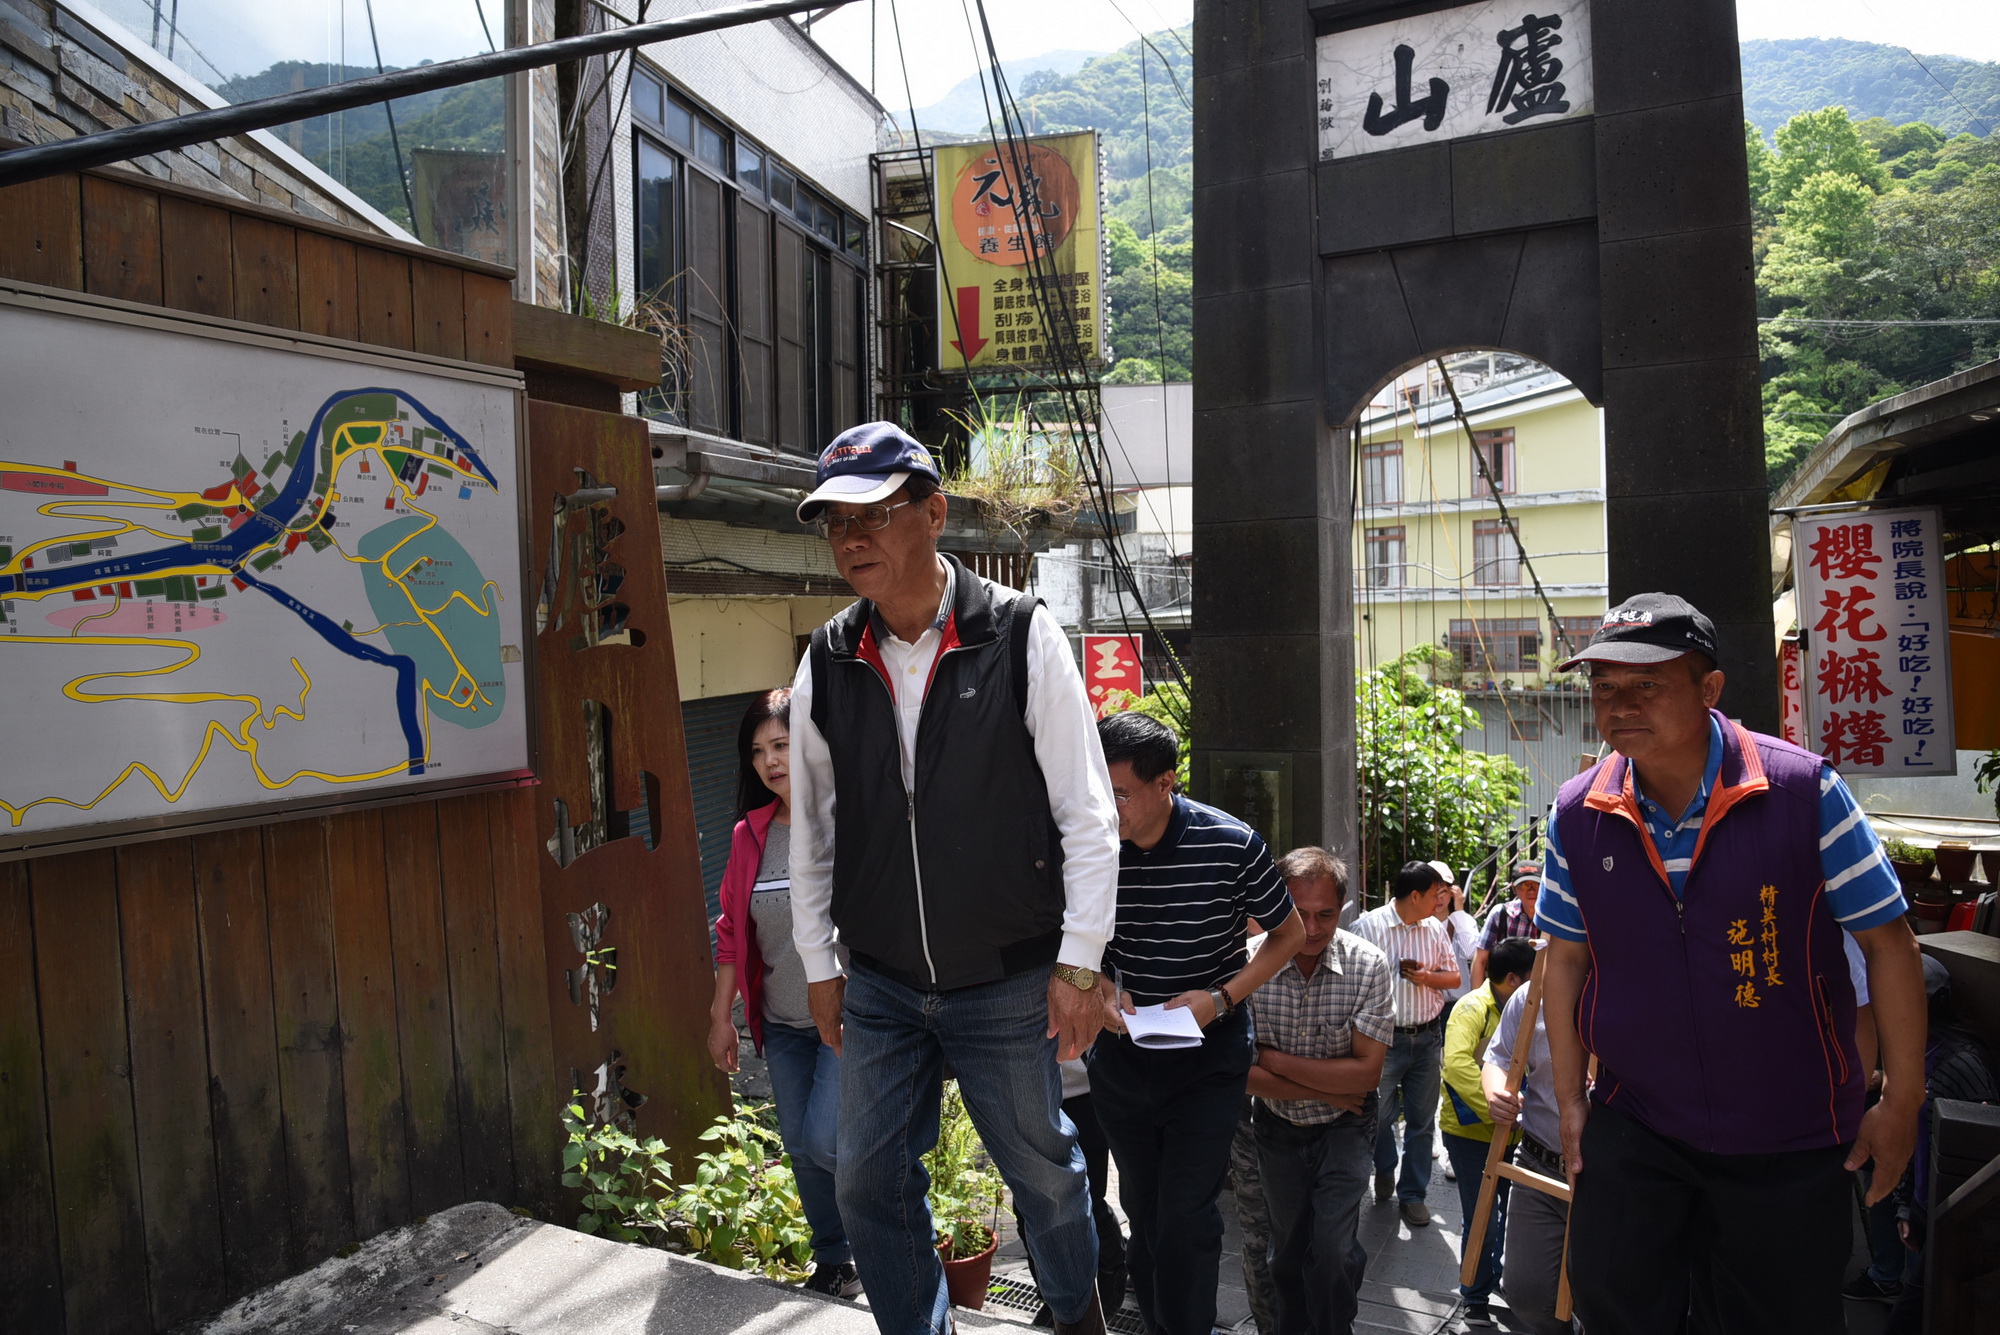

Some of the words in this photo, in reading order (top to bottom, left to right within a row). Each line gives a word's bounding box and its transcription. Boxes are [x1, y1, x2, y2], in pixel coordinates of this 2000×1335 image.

[1363, 13, 1571, 137] 廬山
[979, 232, 1055, 254] 養生館
[194, 426, 221, 436] 現在位置
[1727, 919, 1762, 1008] 施明德
[1759, 884, 1784, 987] 精英村村長
